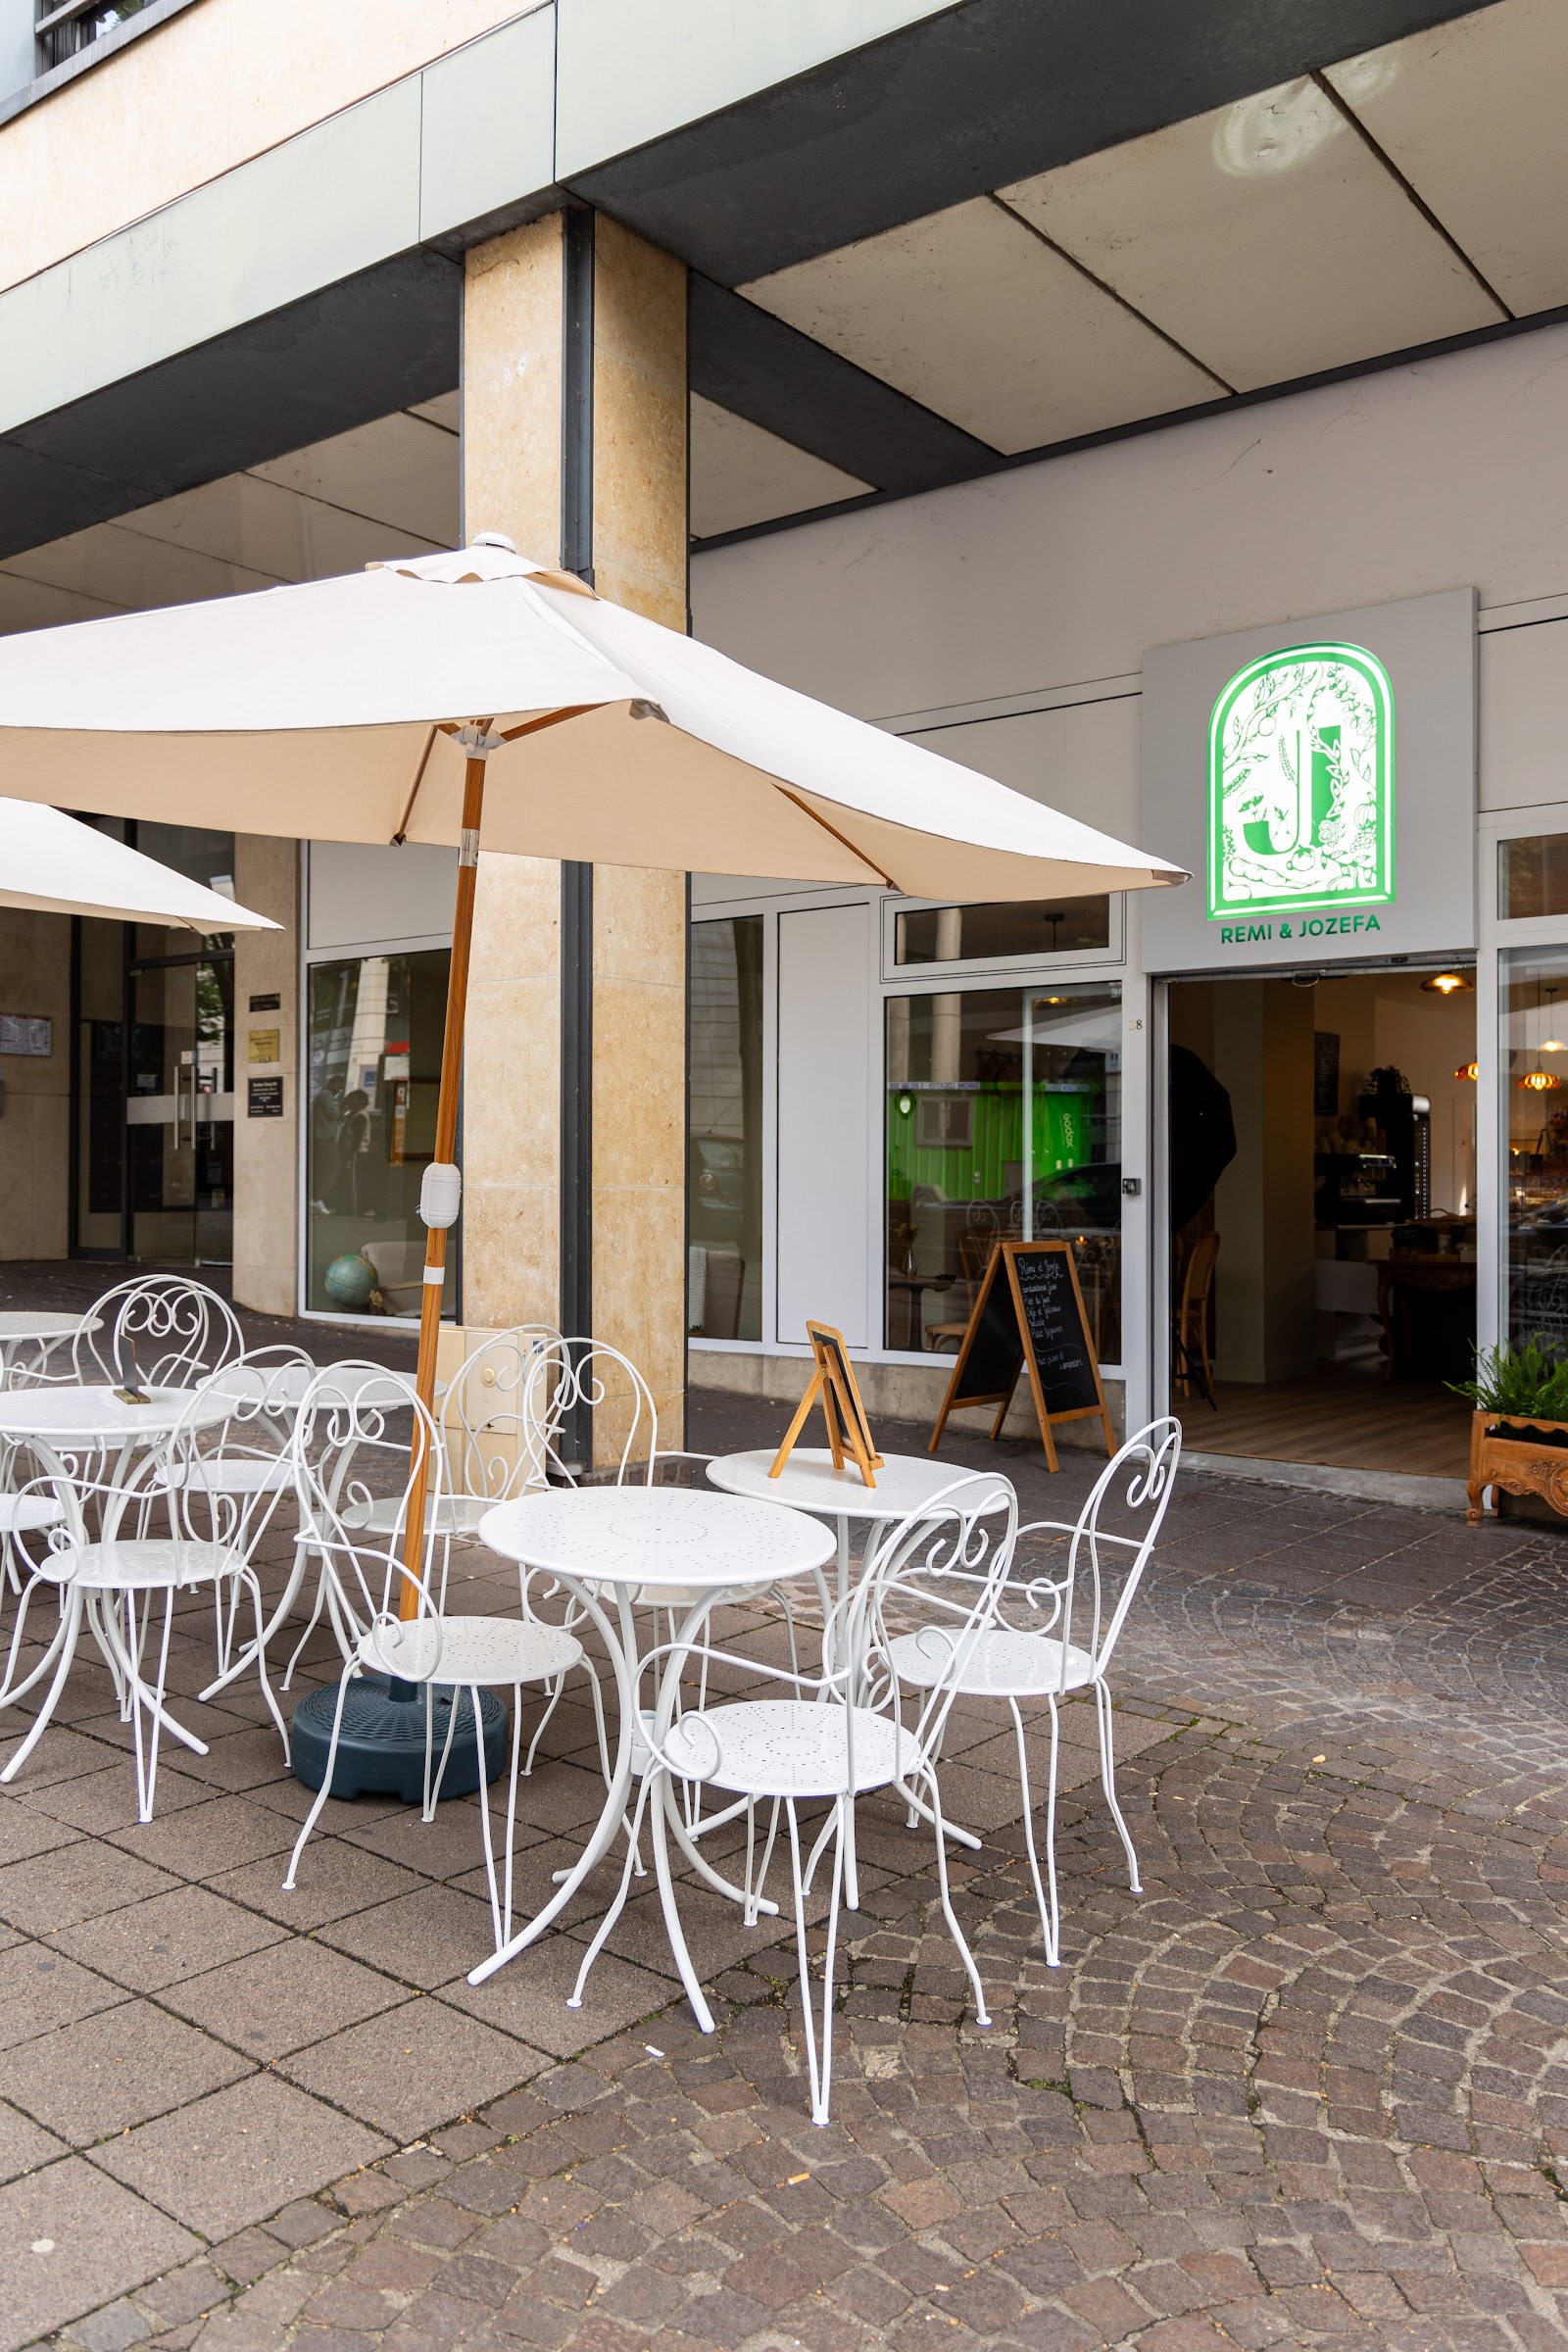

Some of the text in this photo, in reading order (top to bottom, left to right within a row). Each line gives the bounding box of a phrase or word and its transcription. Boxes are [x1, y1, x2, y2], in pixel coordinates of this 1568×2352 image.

[1221, 914, 1381, 945] REMI & JOZEFA
[1129, 1019, 1143, 1031] 18
[1062, 1112, 1075, 1149] Godox
